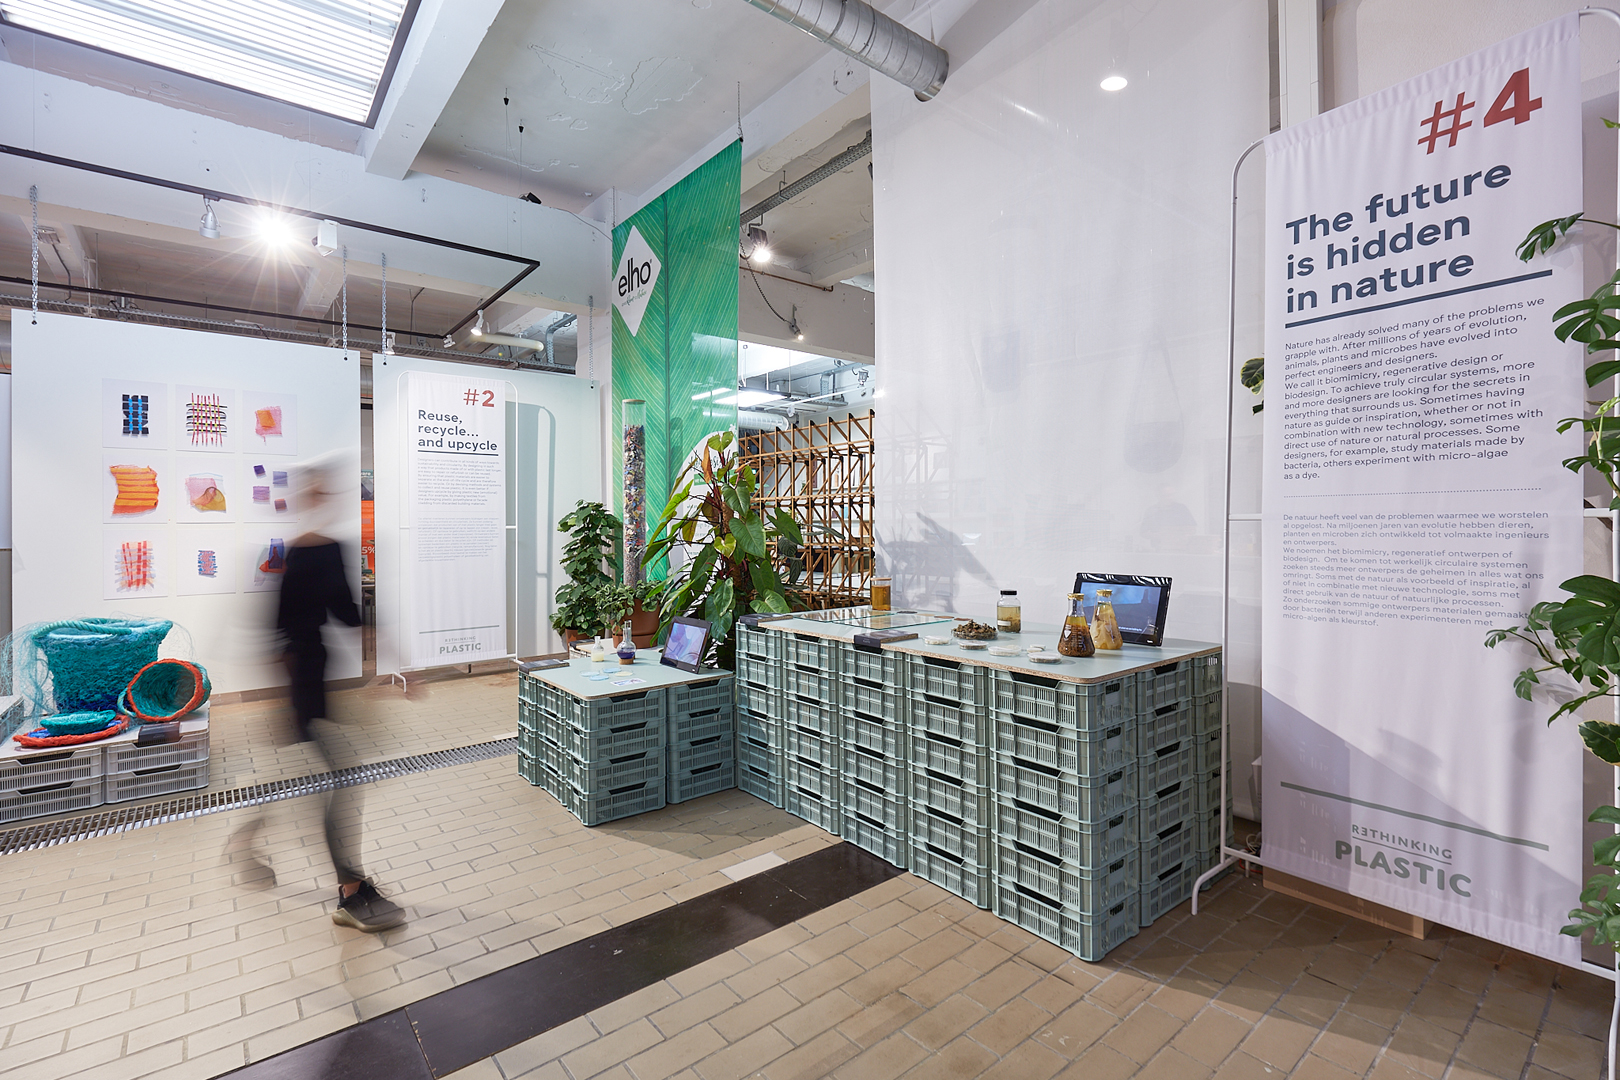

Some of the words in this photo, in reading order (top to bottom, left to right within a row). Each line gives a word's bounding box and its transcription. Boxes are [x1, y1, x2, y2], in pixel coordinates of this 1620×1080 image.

[1417, 67, 1543, 155] #4
[1286, 212, 1354, 245] The
[1366, 164, 1512, 223] future
[1287, 254, 1314, 280] is
[1328, 215, 1471, 270] hidden
[618, 257, 651, 297] elho
[1287, 288, 1318, 313] in
[1331, 254, 1475, 304] nature
[1285, 340, 1314, 350] Nature
[1315, 337, 1331, 345] has
[1332, 330, 1366, 342] already
[1368, 322, 1400, 335] solved
[1401, 319, 1430, 329] many
[1432, 314, 1445, 324] of
[1447, 311, 1466, 321] the
[1468, 302, 1524, 320] problems
[1526, 298, 1544, 307] we
[1285, 349, 1317, 361] grapple
[1318, 345, 1340, 354] with.
[1342, 341, 1367, 350] After
[1368, 335, 1407, 346] millions
[1409, 330, 1421, 339] of
[1423, 327, 1451, 339] years
[1453, 322, 1466, 332] of
[1469, 314, 1527, 329] evolution,
[1285, 359, 1320, 370] animals,
[1321, 354, 1349, 366] plants
[1350, 349, 1369, 360] and
[1371, 343, 1418, 356] microbes
[1420, 339, 1445, 349] have
[1448, 330, 1491, 344] evolved
[1493, 326, 1518, 337] into
[1285, 369, 1316, 381] perfect
[1318, 364, 1363, 375] engineers
[1364, 358, 1383, 368] and
[1384, 353, 1437, 365] designers.
[1285, 382, 1299, 390] We
[1300, 379, 1315, 388] call
[1325, 372, 1381, 384] biomimicry,
[1382, 361, 1448, 377] regenerative
[1450, 356, 1488, 367] design
[1285, 389, 1330, 400] biodesign.
[1331, 386, 1343, 394] To
[1344, 382, 1382, 392] achieve
[1383, 377, 1406, 387] truly
[1408, 372, 1448, 384] circular
[1450, 367, 1500, 380] systems,
[1502, 362, 1535, 372] more
[464, 388, 494, 408] #2
[1284, 401, 1300, 410] and
[1302, 400, 1325, 408] more
[1326, 394, 1372, 405] designers
[1392, 386, 1430, 397] looking
[1432, 384, 1449, 392] for
[1451, 381, 1470, 390] the
[1472, 375, 1517, 387] secrets
[1519, 373, 1530, 382] in
[1284, 409, 1329, 419] everything
[1330, 405, 1350, 415] that
[1351, 400, 1401, 412] surrounds
[1419, 393, 1483, 405] Sometimes
[1485, 387, 1525, 398] having
[418, 410, 462, 424] Reuse,
[1284, 421, 1312, 429] nature
[1325, 417, 1351, 428] guide
[1365, 410, 1421, 422] inspiration,
[1423, 405, 1469, 416] whether
[1486, 399, 1508, 410] not
[1510, 399, 1521, 407] in
[1284, 429, 1339, 439] combination
[1340, 425, 1361, 435] with
[1363, 425, 1384, 433] new
[1385, 419, 1447, 431] technology,
[1449, 413, 1514, 425] sometimes
[1516, 408, 1543, 419] with
[418, 425, 478, 437] recycle...
[418, 438, 443, 448] and
[448, 440, 498, 452] upcycle
[1284, 441, 1309, 449] direct
[1327, 438, 1338, 446] of
[1340, 437, 1371, 445] nature
[1385, 431, 1421, 442] natural
[1423, 429, 1482, 441] processes.
[1484, 425, 1520, 434] Some
[1283, 451, 1328, 460] designers,
[1345, 446, 1389, 456] example,
[1391, 443, 1419, 453] study
[1421, 439, 1472, 450] materials
[1474, 436, 1508, 446] made
[1510, 435, 1525, 446] by
[1283, 461, 1321, 469] bacteria,
[1323, 459, 1353, 467] others
[1354, 455, 1411, 467] experiment
[1413, 453, 1436, 462] with
[1438, 449, 1508, 460] micro-algae
[1302, 472, 1320, 481] dye.
[1290, 522, 1325, 530] opgelost.
[1338, 522, 1379, 530] miljoenen
[1380, 522, 1402, 530] jaren
[1498, 521, 1534, 529] dieren,
[1387, 513, 1435, 521] problemen
[1283, 530, 1310, 538] planten
[1495, 531, 1549, 540] ingenieurs
[1293, 539, 1337, 547] ontwerpers.
[1342, 548, 1390, 557] biomimicry,
[1447, 550, 1500, 559] ontwerpen
[440, 643, 482, 654] PLASTIC
[1336, 840, 1472, 898] PLASTIC
